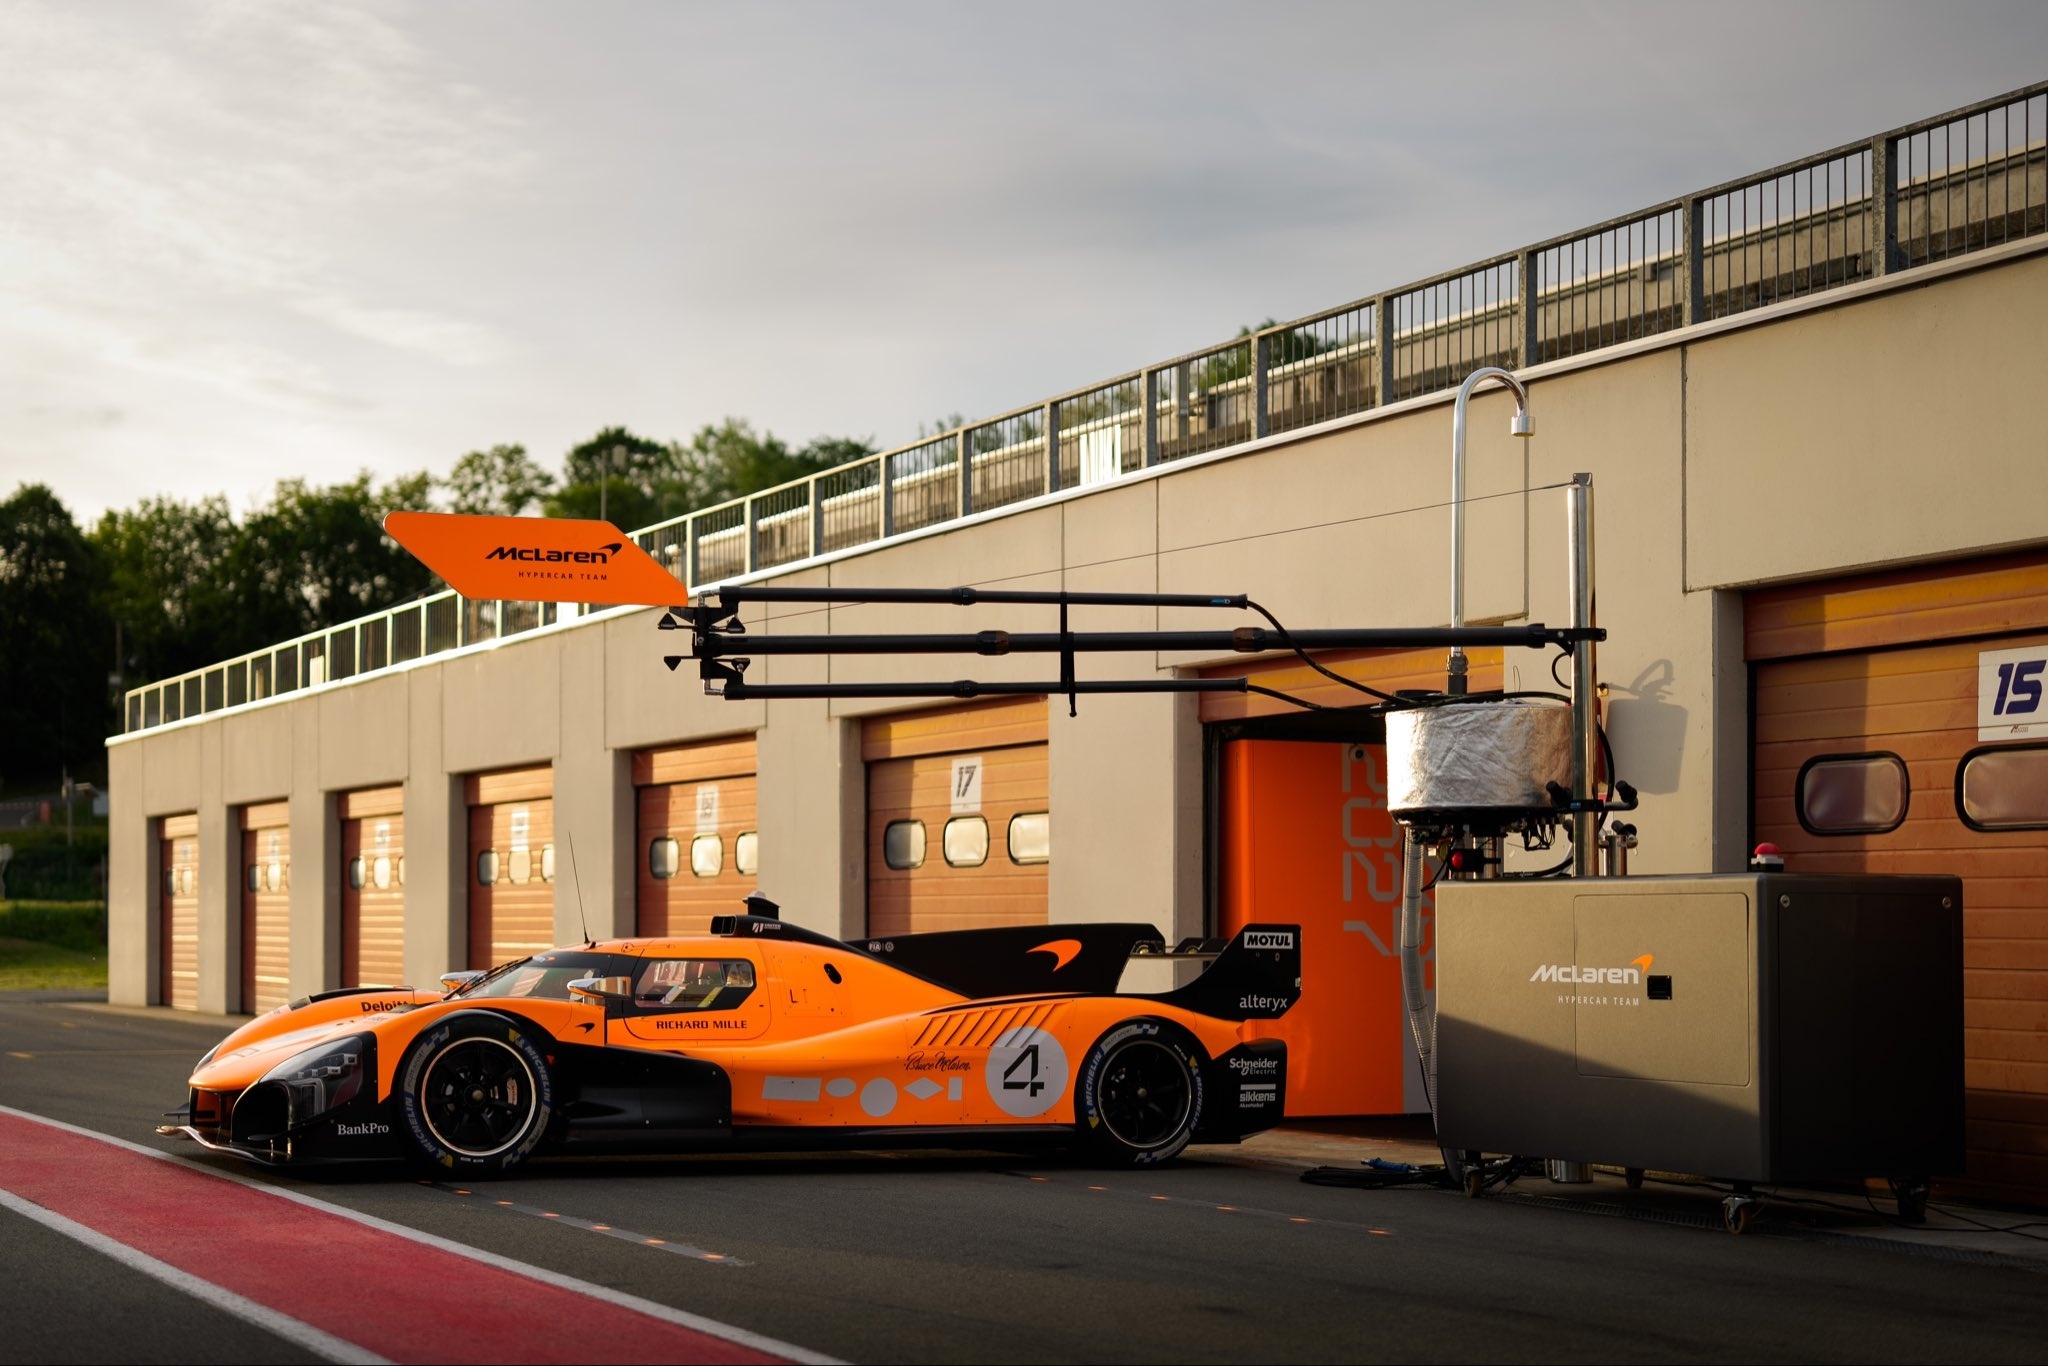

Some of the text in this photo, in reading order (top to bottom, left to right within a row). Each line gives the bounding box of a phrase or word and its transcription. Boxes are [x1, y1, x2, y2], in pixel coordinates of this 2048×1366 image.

[485, 546, 607, 564] McLaren
[518, 571, 608, 581] HYPERCAR TEAM
[1993, 660, 2047, 716] 15
[956, 765, 977, 798] 17
[1246, 934, 1291, 946] MOTUL
[1529, 964, 1639, 984] McLaren
[1239, 994, 1288, 1012] alteryx
[1558, 995, 1640, 1006] HYPERCAR TEAM
[656, 1020, 747, 1029] RICHARD MILLE
[1003, 1044, 1045, 1097] 4
[1229, 1058, 1278, 1069] Schneider
[524, 1045, 551, 1101] MICHELIN
[1085, 1051, 1103, 1106] MICHELIN
[1190, 1075, 1203, 1131] MICHELIN
[1239, 1091, 1276, 1102] sikkens
[337, 1123, 389, 1136] BankPro
[404, 1096, 436, 1152] MICHELIN
